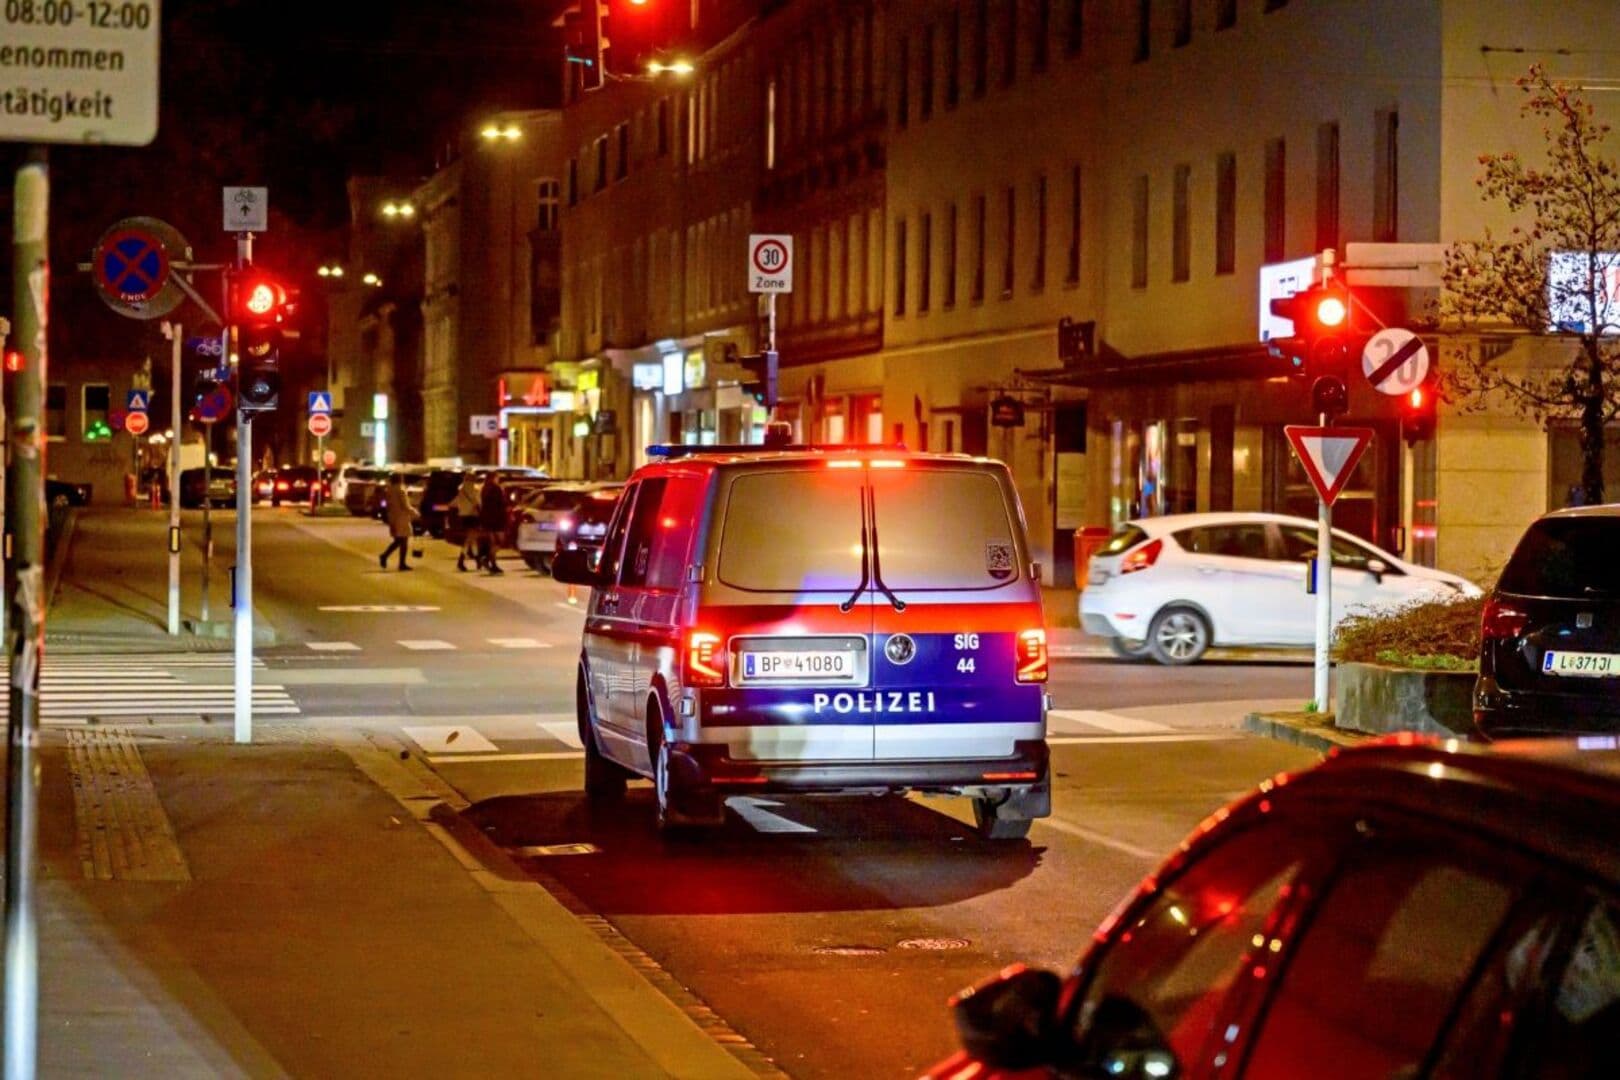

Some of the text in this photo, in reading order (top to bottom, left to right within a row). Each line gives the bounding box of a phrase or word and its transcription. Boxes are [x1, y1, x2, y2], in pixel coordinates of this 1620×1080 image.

[6, 0, 150, 29] 08:00-12:00
[763, 248, 779, 265] 30
[756, 276, 785, 288] Zone
[954, 634, 979, 650] SIG
[761, 657, 782, 672] BP
[794, 656, 843, 671] 41080
[956, 658, 976, 673] 44
[813, 692, 935, 713] POLIZEI
